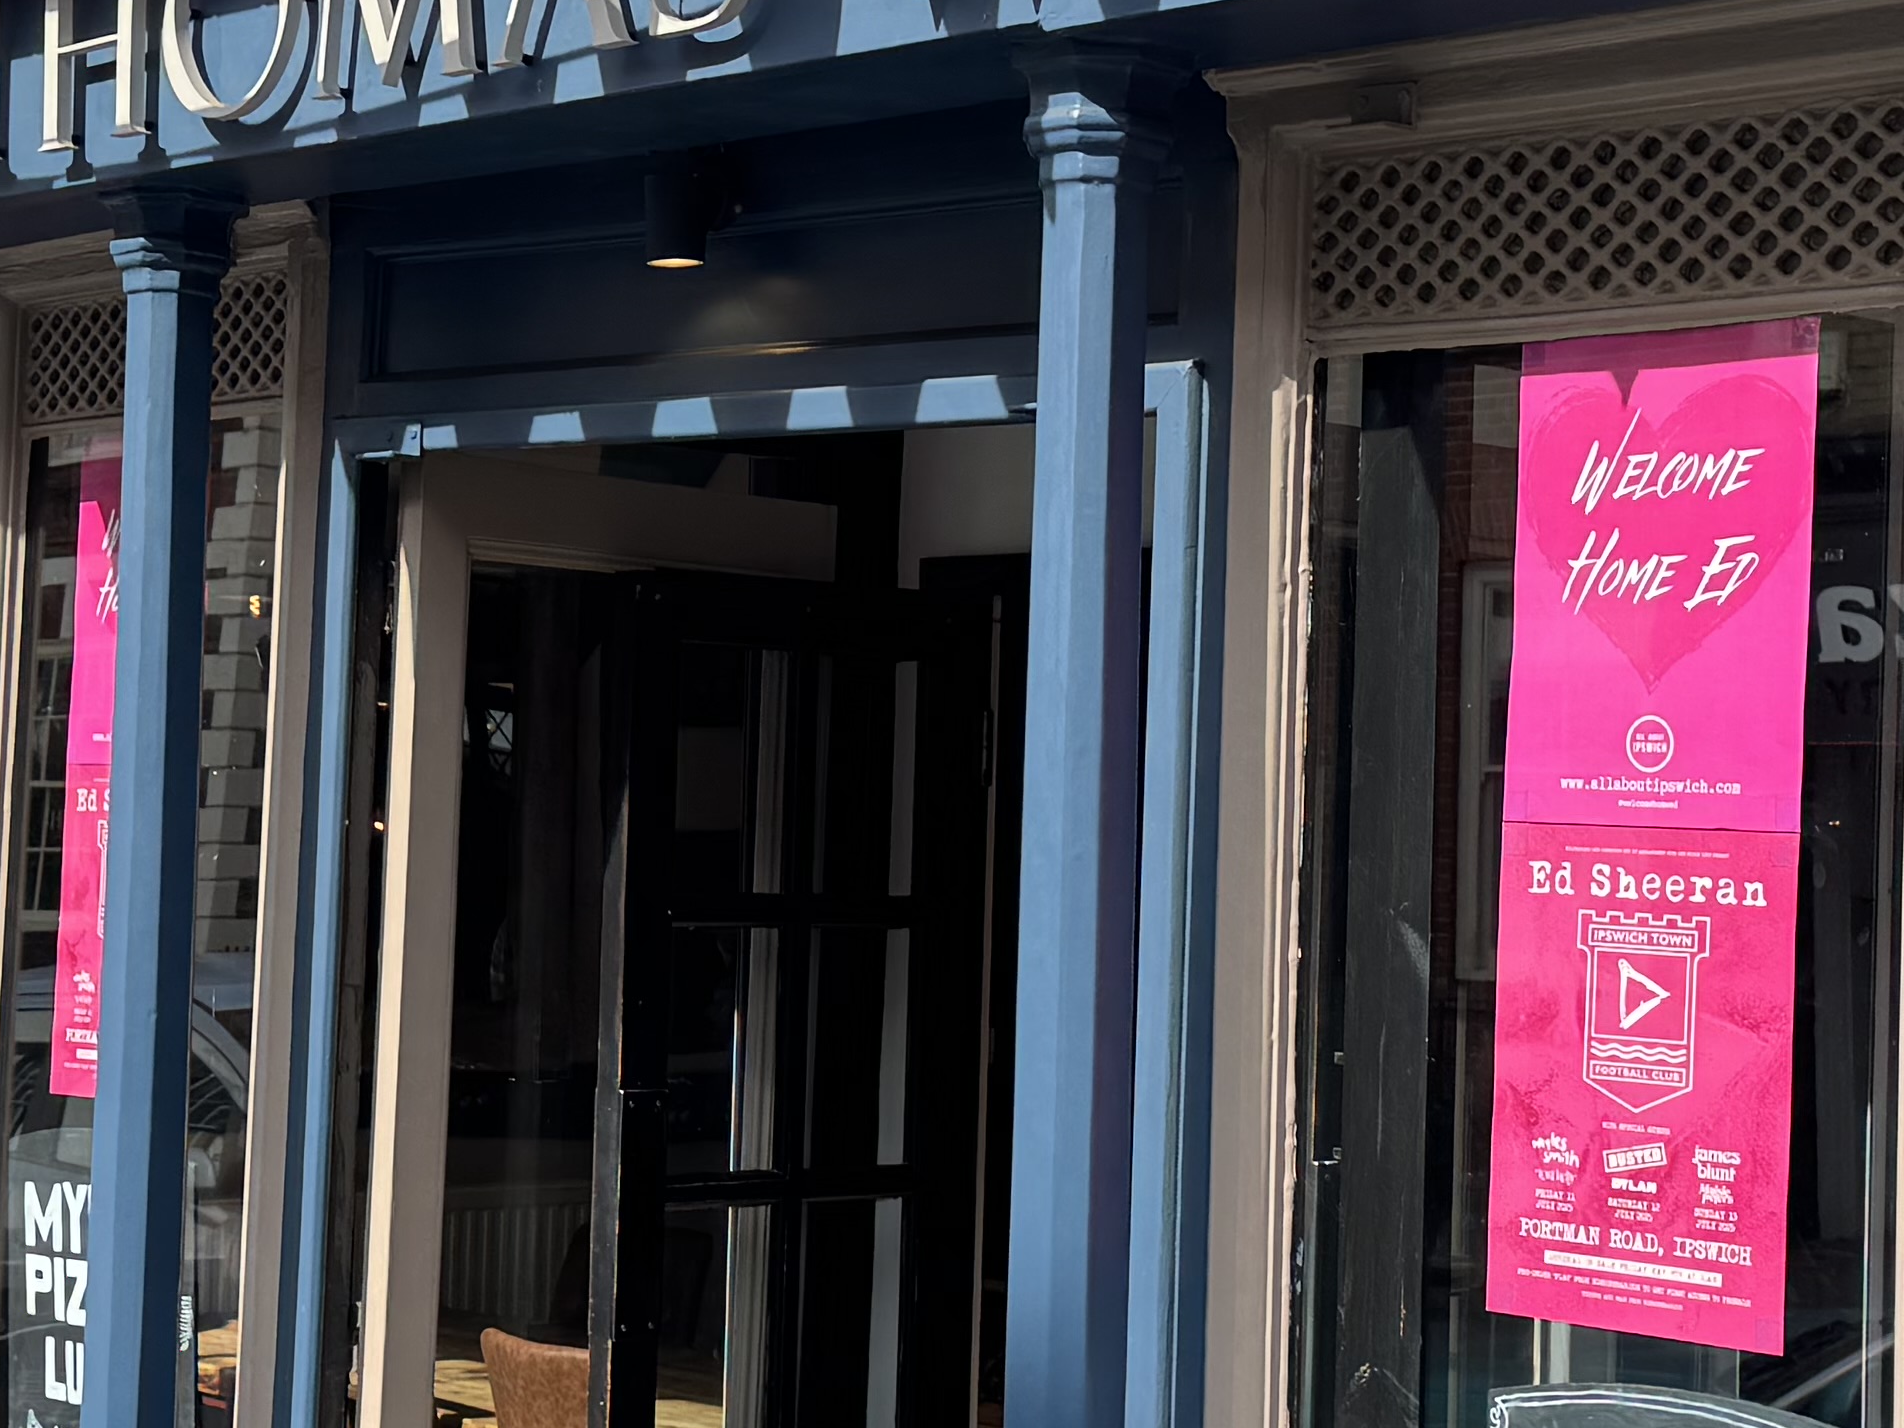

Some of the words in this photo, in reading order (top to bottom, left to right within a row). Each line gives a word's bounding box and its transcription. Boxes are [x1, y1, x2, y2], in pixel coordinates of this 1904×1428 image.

[1632, 741, 1668, 754] IPSWICH
[1560, 776, 1742, 796] www.allaboutipswich.com
[76, 787, 97, 813] Ed
[1528, 860, 1575, 897] Ed
[1589, 862, 1768, 908] Sheeran
[1593, 929, 1648, 945] IPSWICH
[1651, 933, 1693, 948] TOWN
[1594, 1064, 1649, 1080] FOOTBALL
[1651, 1070, 1681, 1082] CLUB
[1543, 1149, 1581, 1168] smith
[1691, 1144, 1742, 1165] james
[1696, 1163, 1737, 1183] blunt
[1519, 1216, 1601, 1246] PORTMAN
[1608, 1228, 1665, 1258] ROAD,
[1672, 1236, 1753, 1267] IPSWICH
[24, 1252, 89, 1327] PIZ
